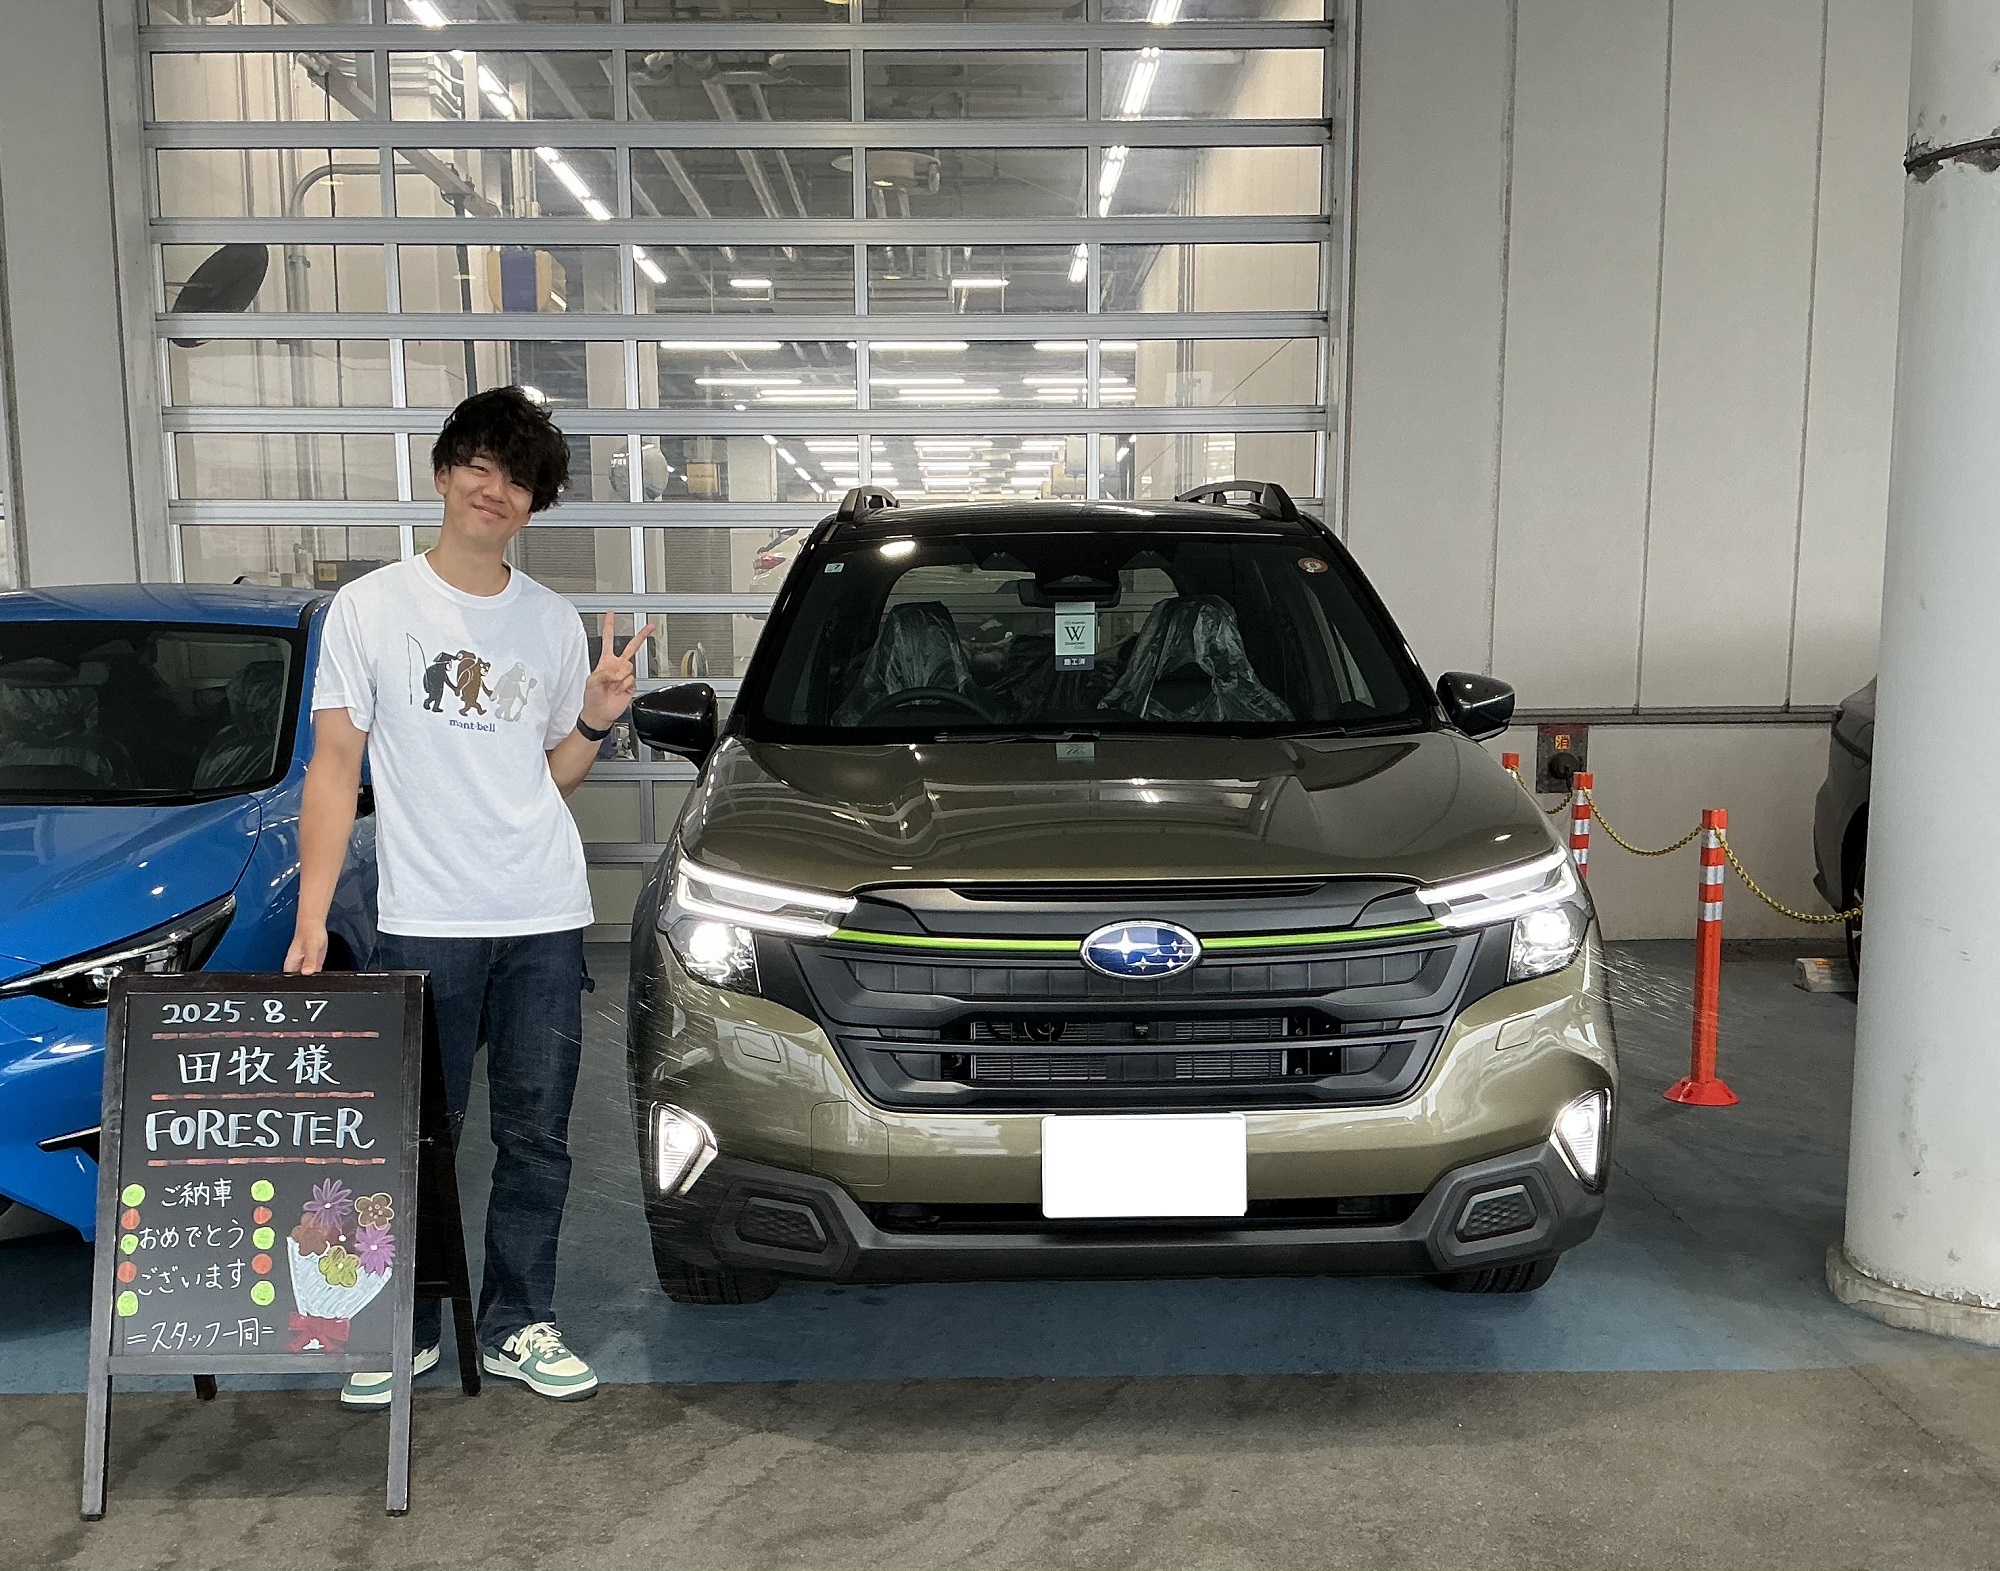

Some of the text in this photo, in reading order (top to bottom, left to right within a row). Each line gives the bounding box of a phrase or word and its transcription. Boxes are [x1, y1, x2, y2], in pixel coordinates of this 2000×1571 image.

[1064, 626, 1086, 641] W
[161, 999, 329, 1024] 2025.8.7
[178, 1044, 341, 1086] 田牧様
[145, 1107, 376, 1151] FORESTER
[160, 1177, 234, 1208] ご納車
[138, 1218, 245, 1249] おめでとう
[137, 1258, 246, 1296] ございます
